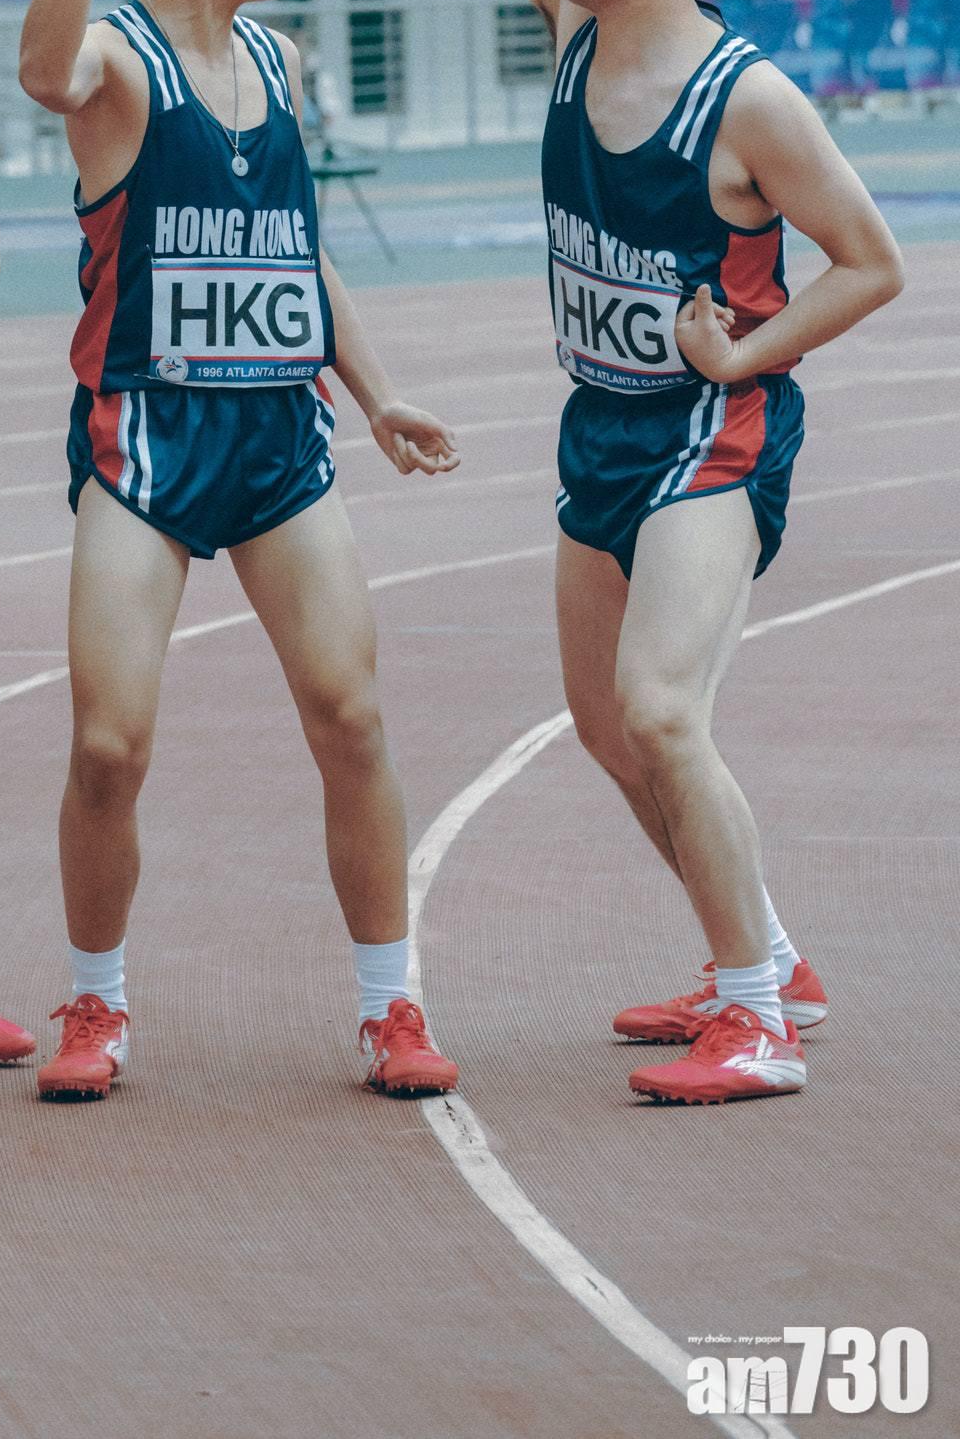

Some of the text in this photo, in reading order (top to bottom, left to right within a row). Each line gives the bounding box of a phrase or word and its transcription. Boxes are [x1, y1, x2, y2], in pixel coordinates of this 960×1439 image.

[154, 206, 311, 257] HONG KONG
[547, 202, 597, 270] HONG
[170, 282, 313, 348] HKG
[551, 276, 669, 365] HKG
[197, 366, 314, 378] 1996 ATLANTA GAMES
[597, 370, 640, 387] ATLANTA
